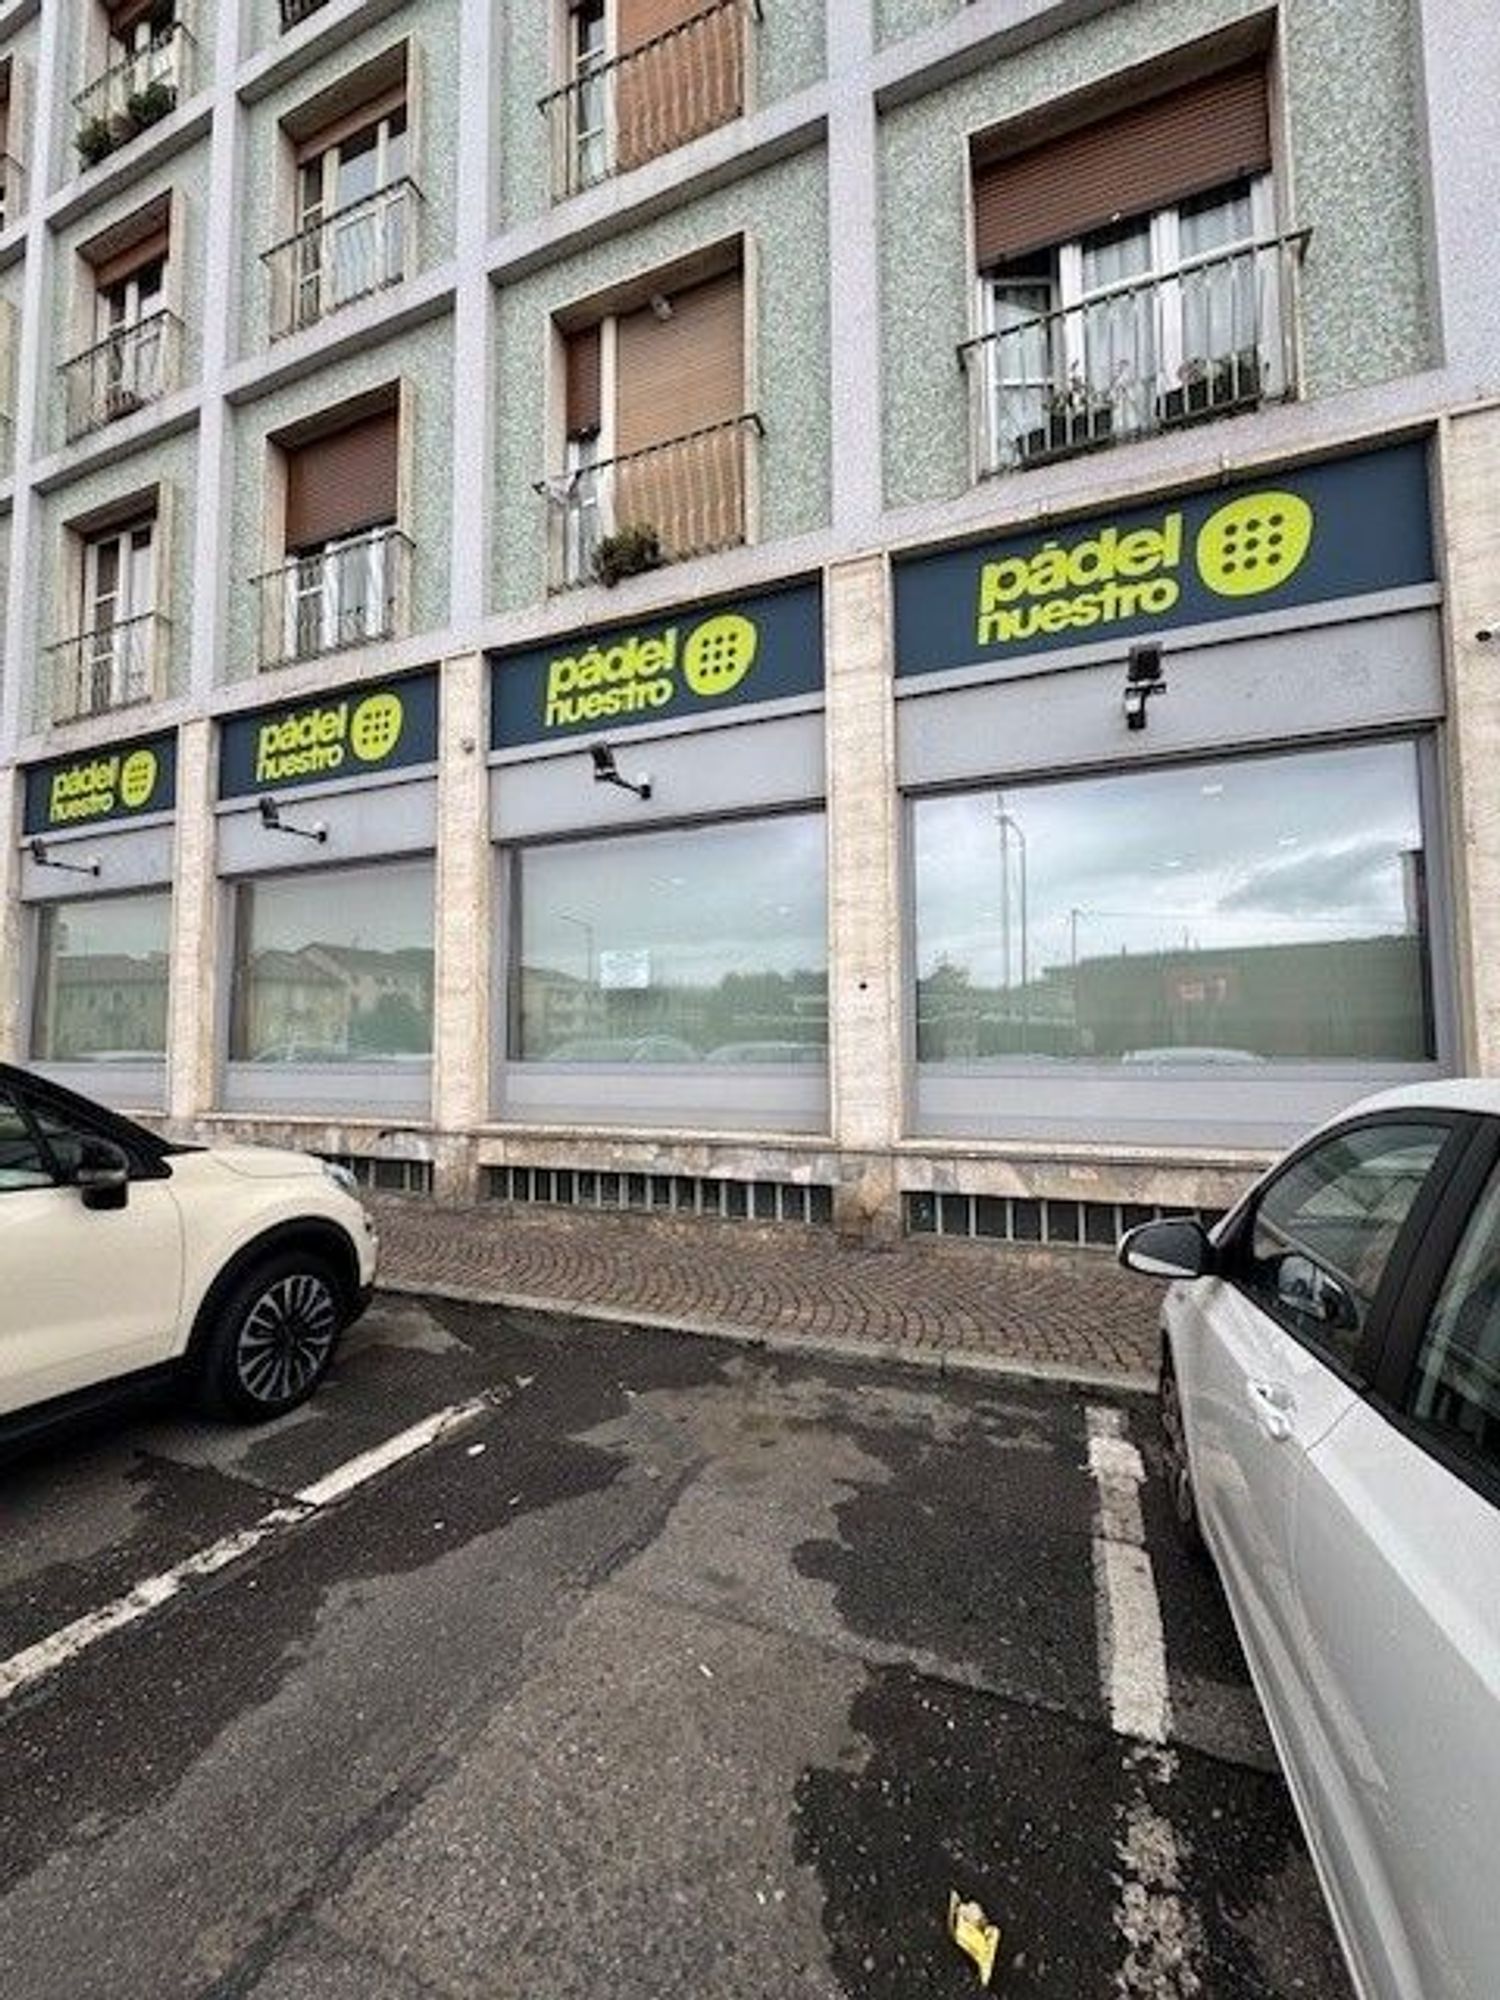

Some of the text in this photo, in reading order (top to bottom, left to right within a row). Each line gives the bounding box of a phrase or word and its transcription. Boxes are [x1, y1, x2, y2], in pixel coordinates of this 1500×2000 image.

[979, 512, 1183, 613] pádel
[978, 577, 1180, 645] nuestro
[547, 627, 678, 701] pádel
[545, 678, 673, 726] nuestro
[256, 744, 344, 782] nuestro
